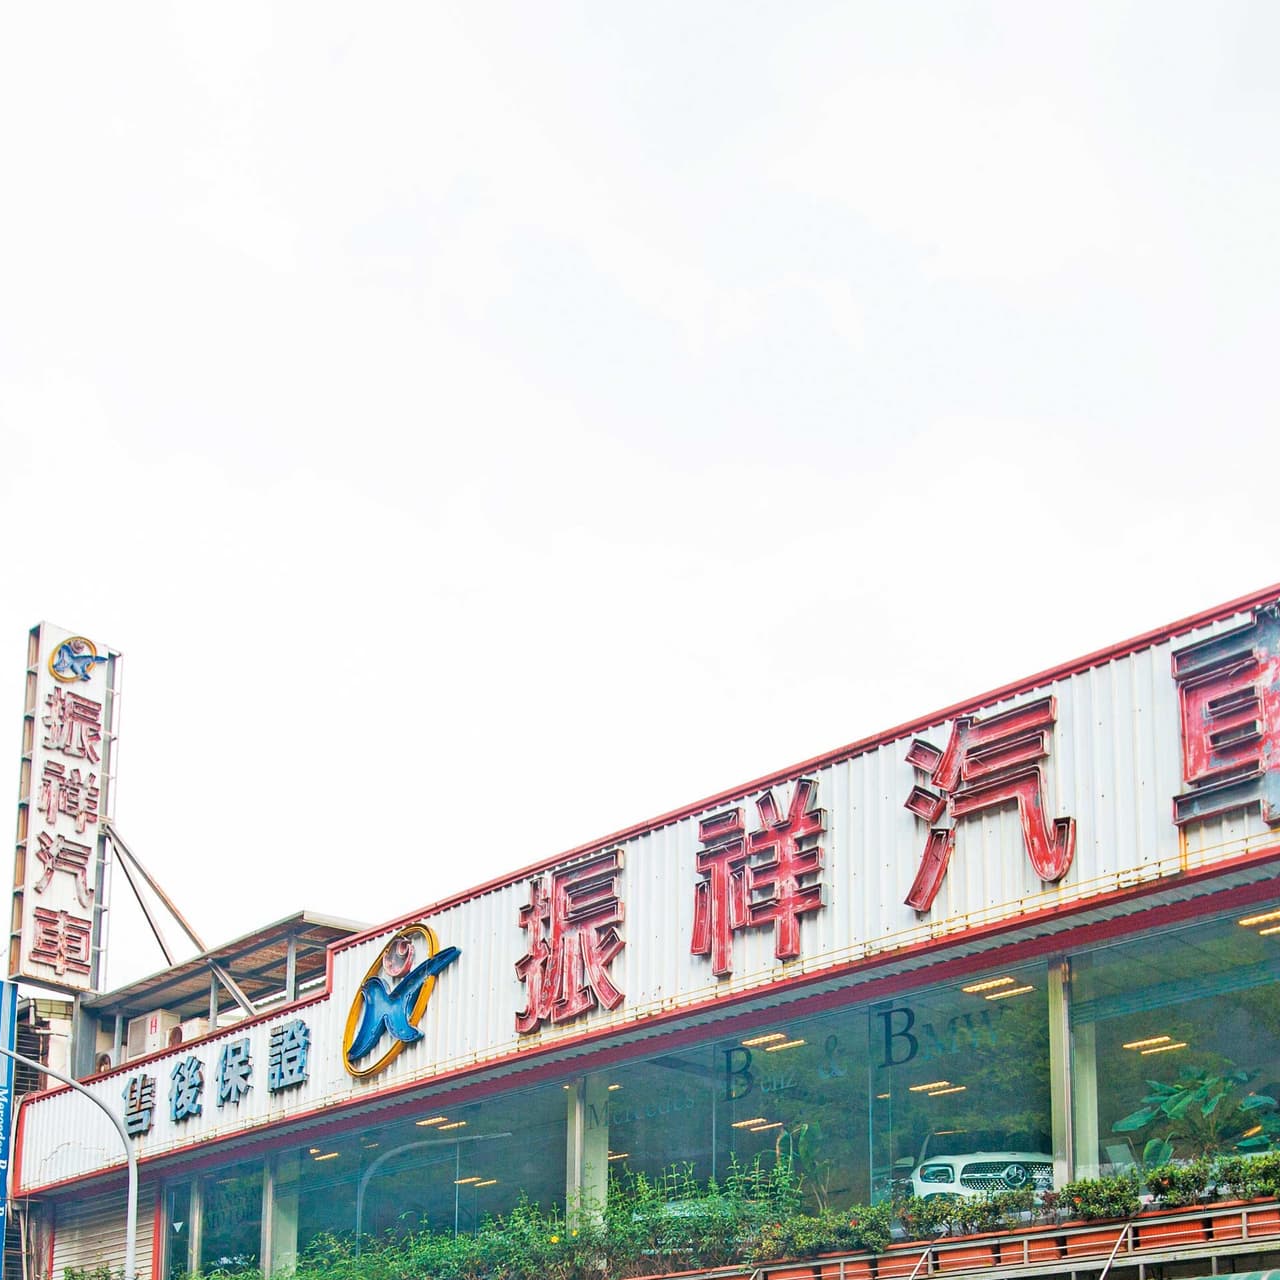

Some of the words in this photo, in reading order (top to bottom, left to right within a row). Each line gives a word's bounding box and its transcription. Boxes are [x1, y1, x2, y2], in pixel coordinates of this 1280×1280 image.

[29, 686, 102, 976] 振祥汽車
[121, 1018, 310, 1136] 售後保證
